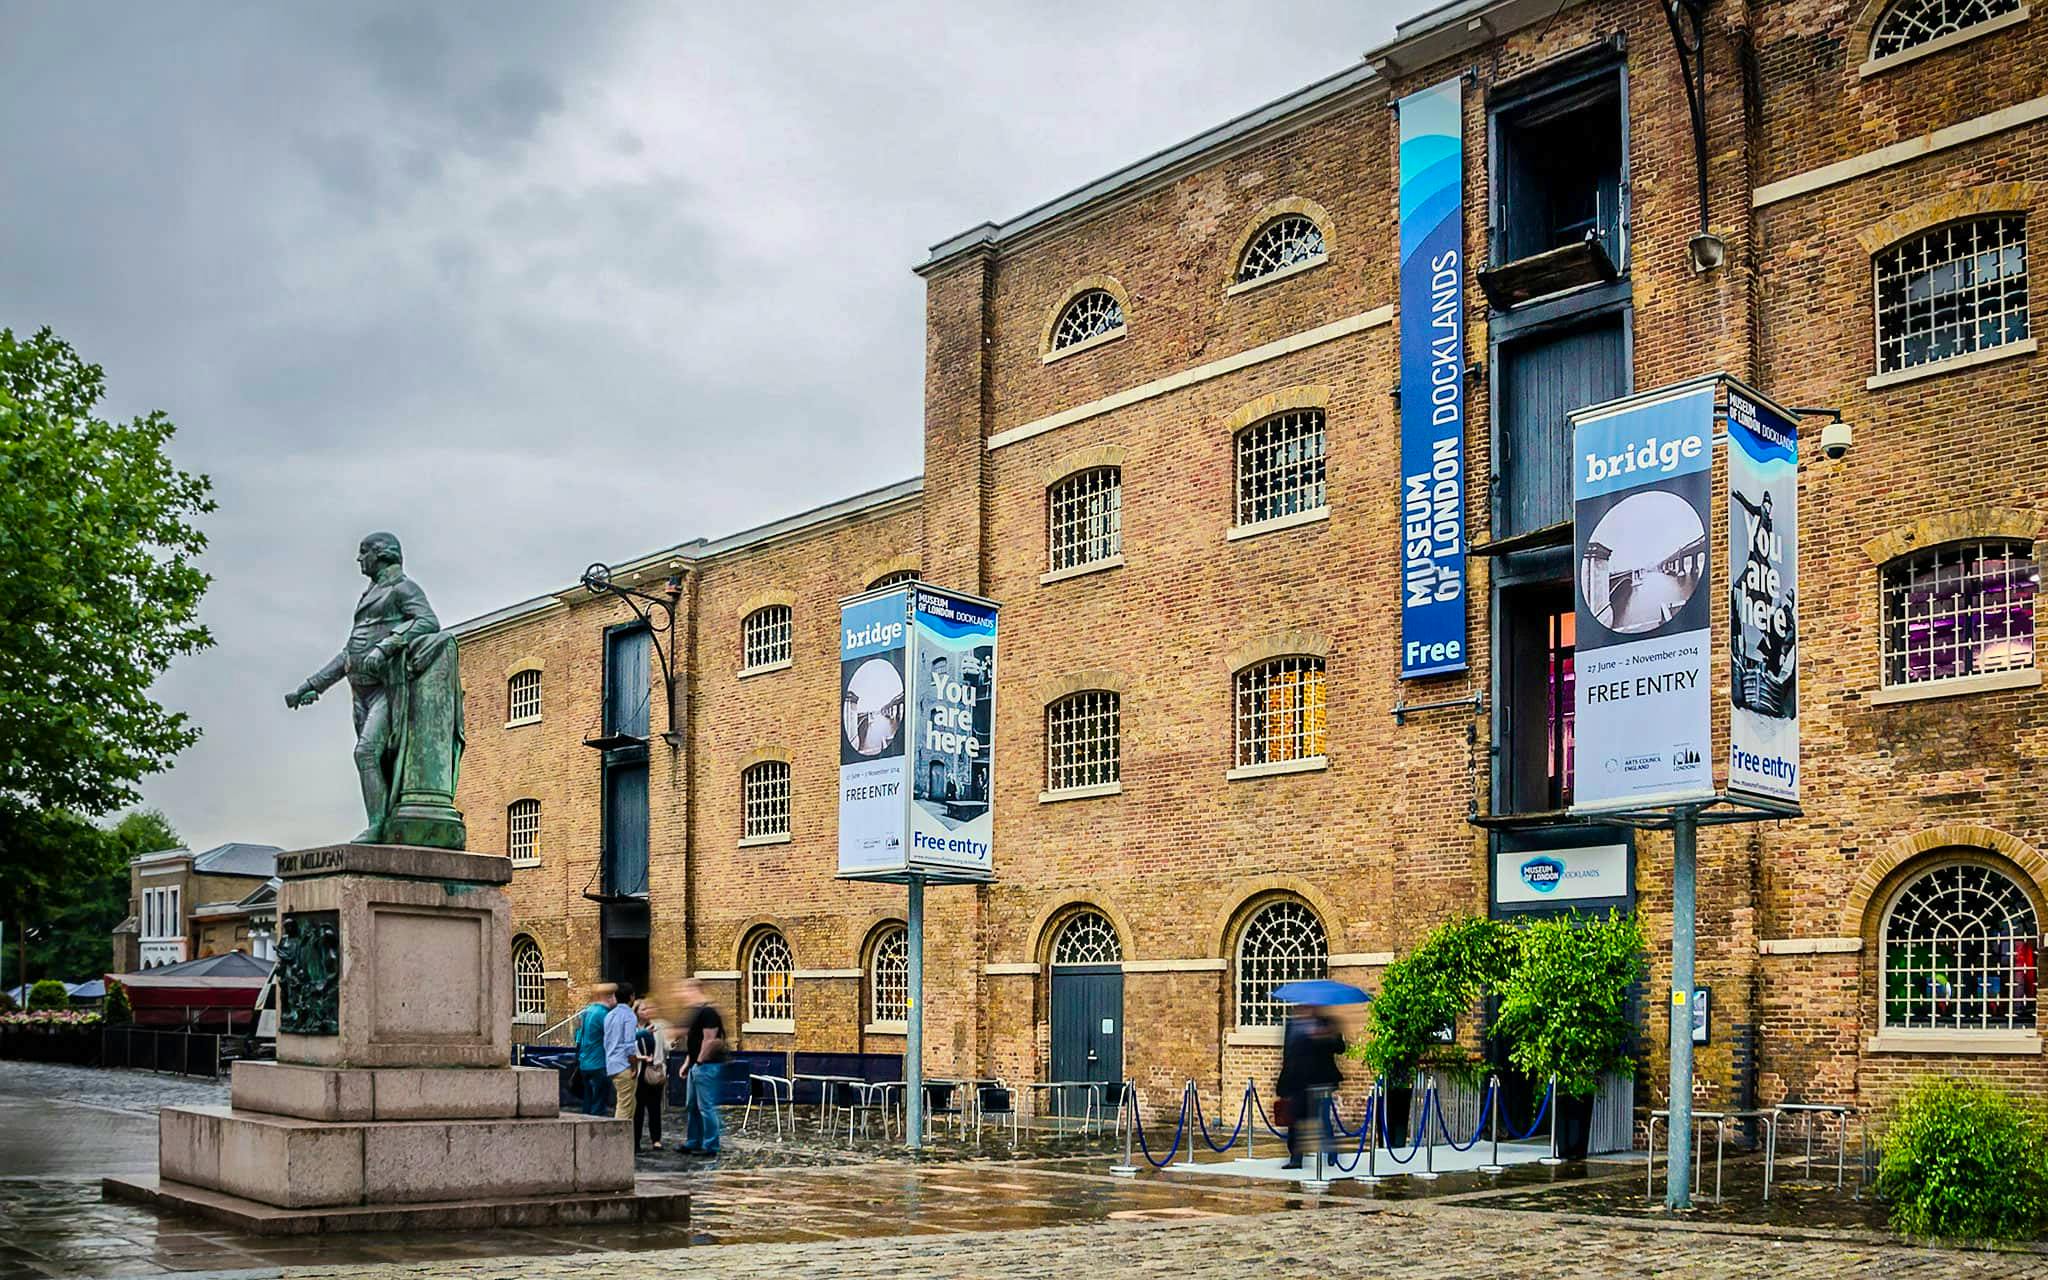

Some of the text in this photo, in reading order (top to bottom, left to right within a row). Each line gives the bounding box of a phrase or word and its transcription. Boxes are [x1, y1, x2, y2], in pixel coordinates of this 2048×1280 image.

[1729, 392, 1756, 418] MUSEUM
[1431, 250, 1461, 602] OF LONDON DOCKLANDS
[1730, 406, 1794, 452] OF LONDON DOCKLANDS
[1586, 435, 1702, 483] bridge
[1406, 472, 1432, 608] MUSEUM
[1744, 510, 1782, 563] You
[1746, 560, 1780, 598] are
[918, 592, 948, 608] MUSEUM
[918, 602, 993, 628] OF LONDON DOCKLANDS
[1741, 581, 1787, 638] here
[846, 621, 902, 650] bridge
[1407, 640, 1460, 666] Free
[1587, 665, 1596, 673] 27
[1597, 661, 1616, 672] June
[1632, 650, 1677, 665] November
[1678, 647, 1698, 657] 2014
[932, 672, 976, 707] You
[1588, 669, 1699, 704] FREE ENTRY
[934, 705, 972, 731] are
[926, 720, 979, 757] here
[1733, 744, 1796, 787] Free entry
[846, 782, 900, 802] FREE ENTRY
[914, 831, 987, 860] Free entry
[1524, 865, 1553, 874] MUSEUM
[1533, 872, 1559, 881] LONDON
